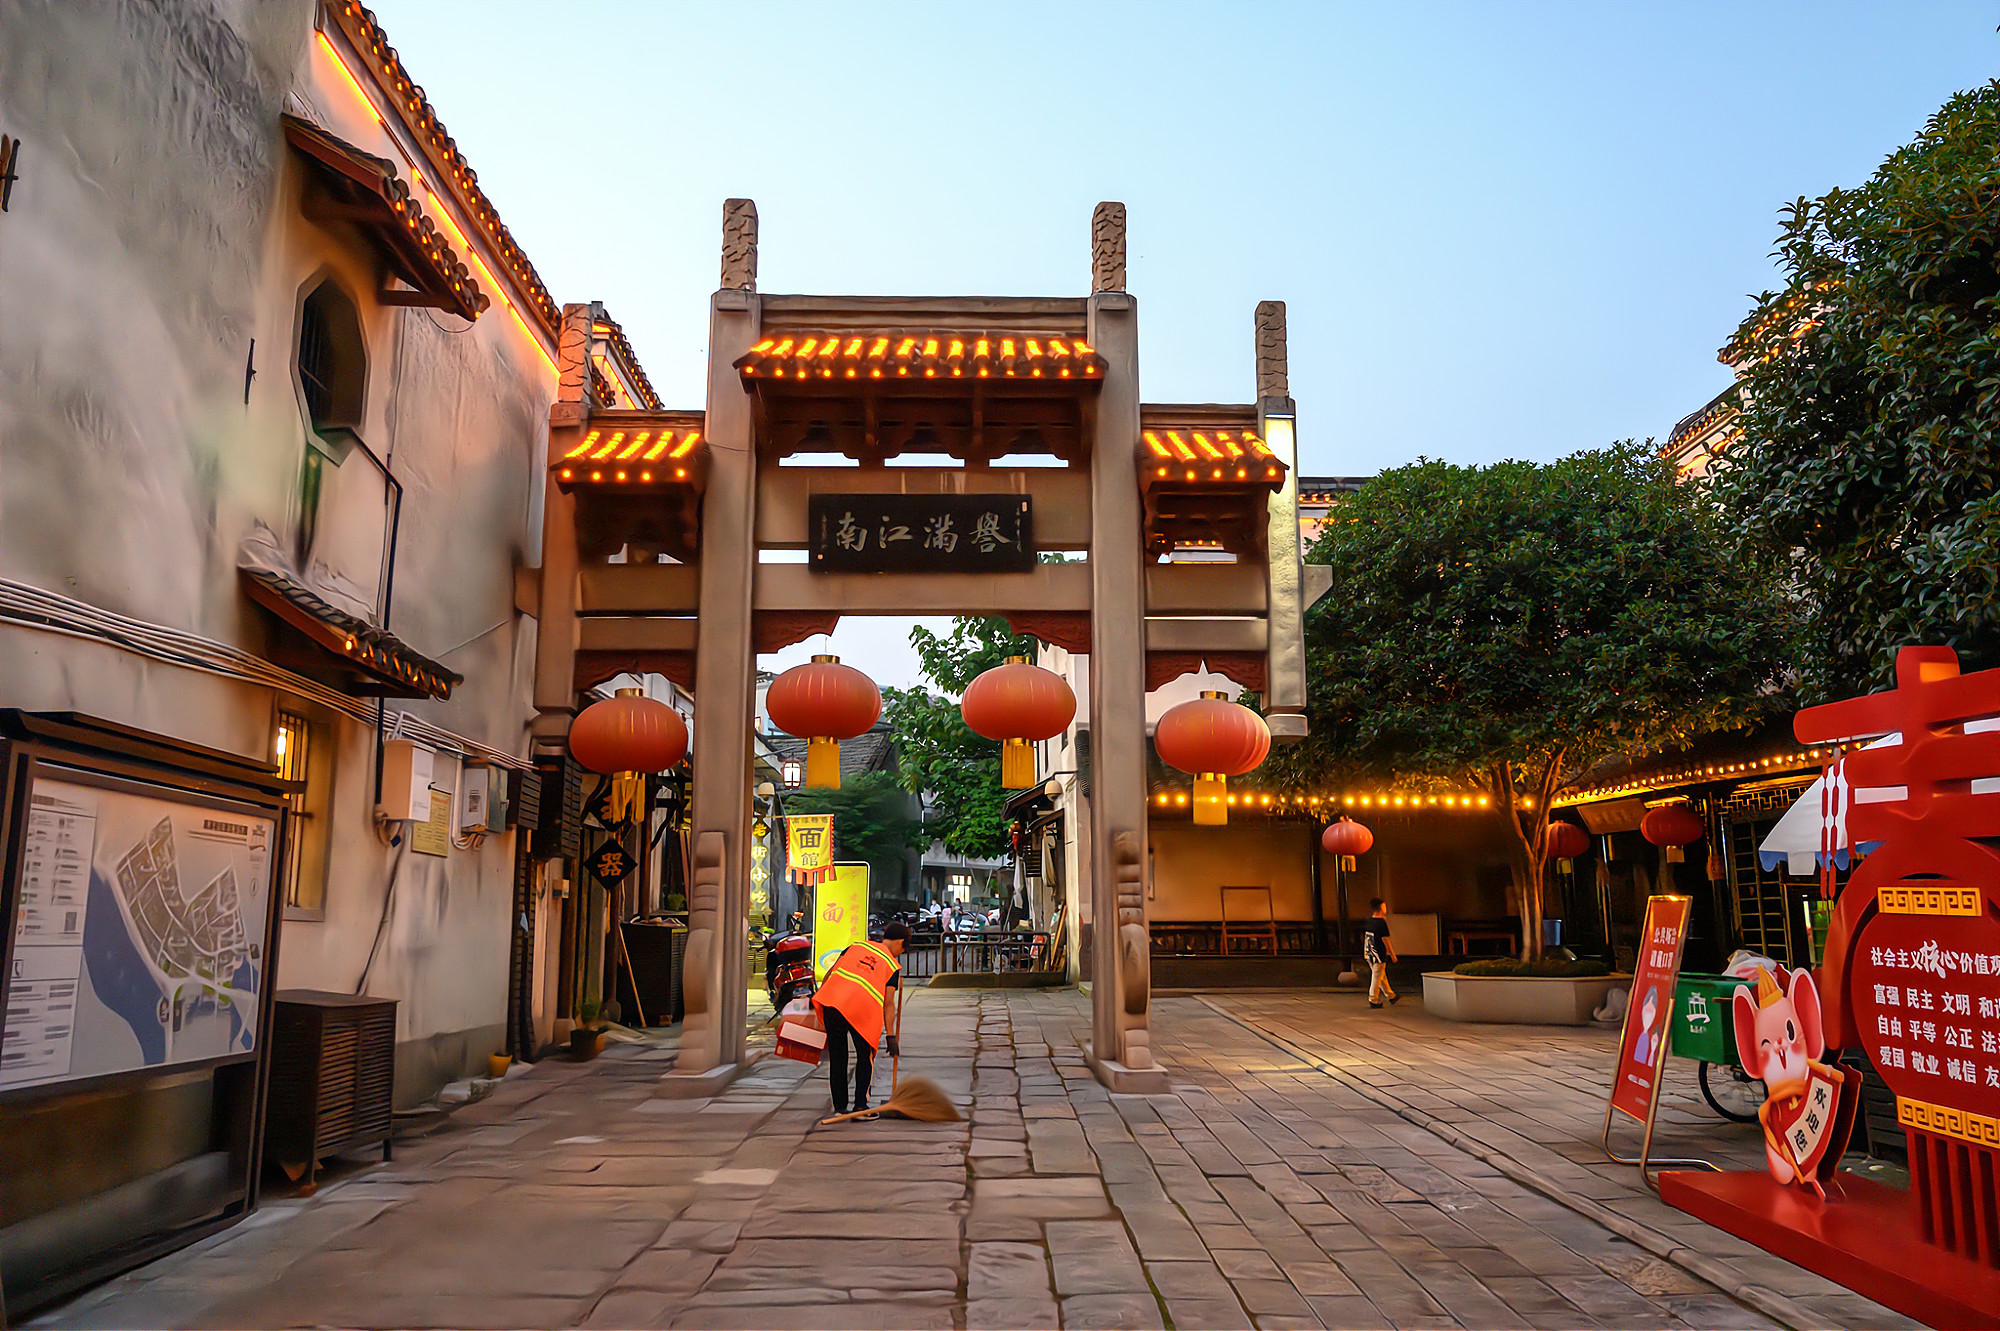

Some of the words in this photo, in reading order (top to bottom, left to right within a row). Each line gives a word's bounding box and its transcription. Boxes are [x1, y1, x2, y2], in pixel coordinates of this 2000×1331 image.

[751, 823, 768, 904] 老街小吃
[822, 902, 845, 924] 面
[1873, 983, 1900, 1006] 富强
[1906, 987, 1934, 1010] 民主
[1941, 991, 1971, 1016] 文明
[1877, 1014, 1902, 1038] 自由
[1908, 1019, 1936, 1043] 平等
[1944, 1025, 1974, 1049] 公正
[1981, 1030, 2000, 1054] 法
[1879, 1045, 1905, 1069] 爱国
[1911, 1050, 1940, 1076] 敬业
[1946, 1057, 1977, 1084] 诚信
[1793, 1086, 1827, 1153] 欢迎您
